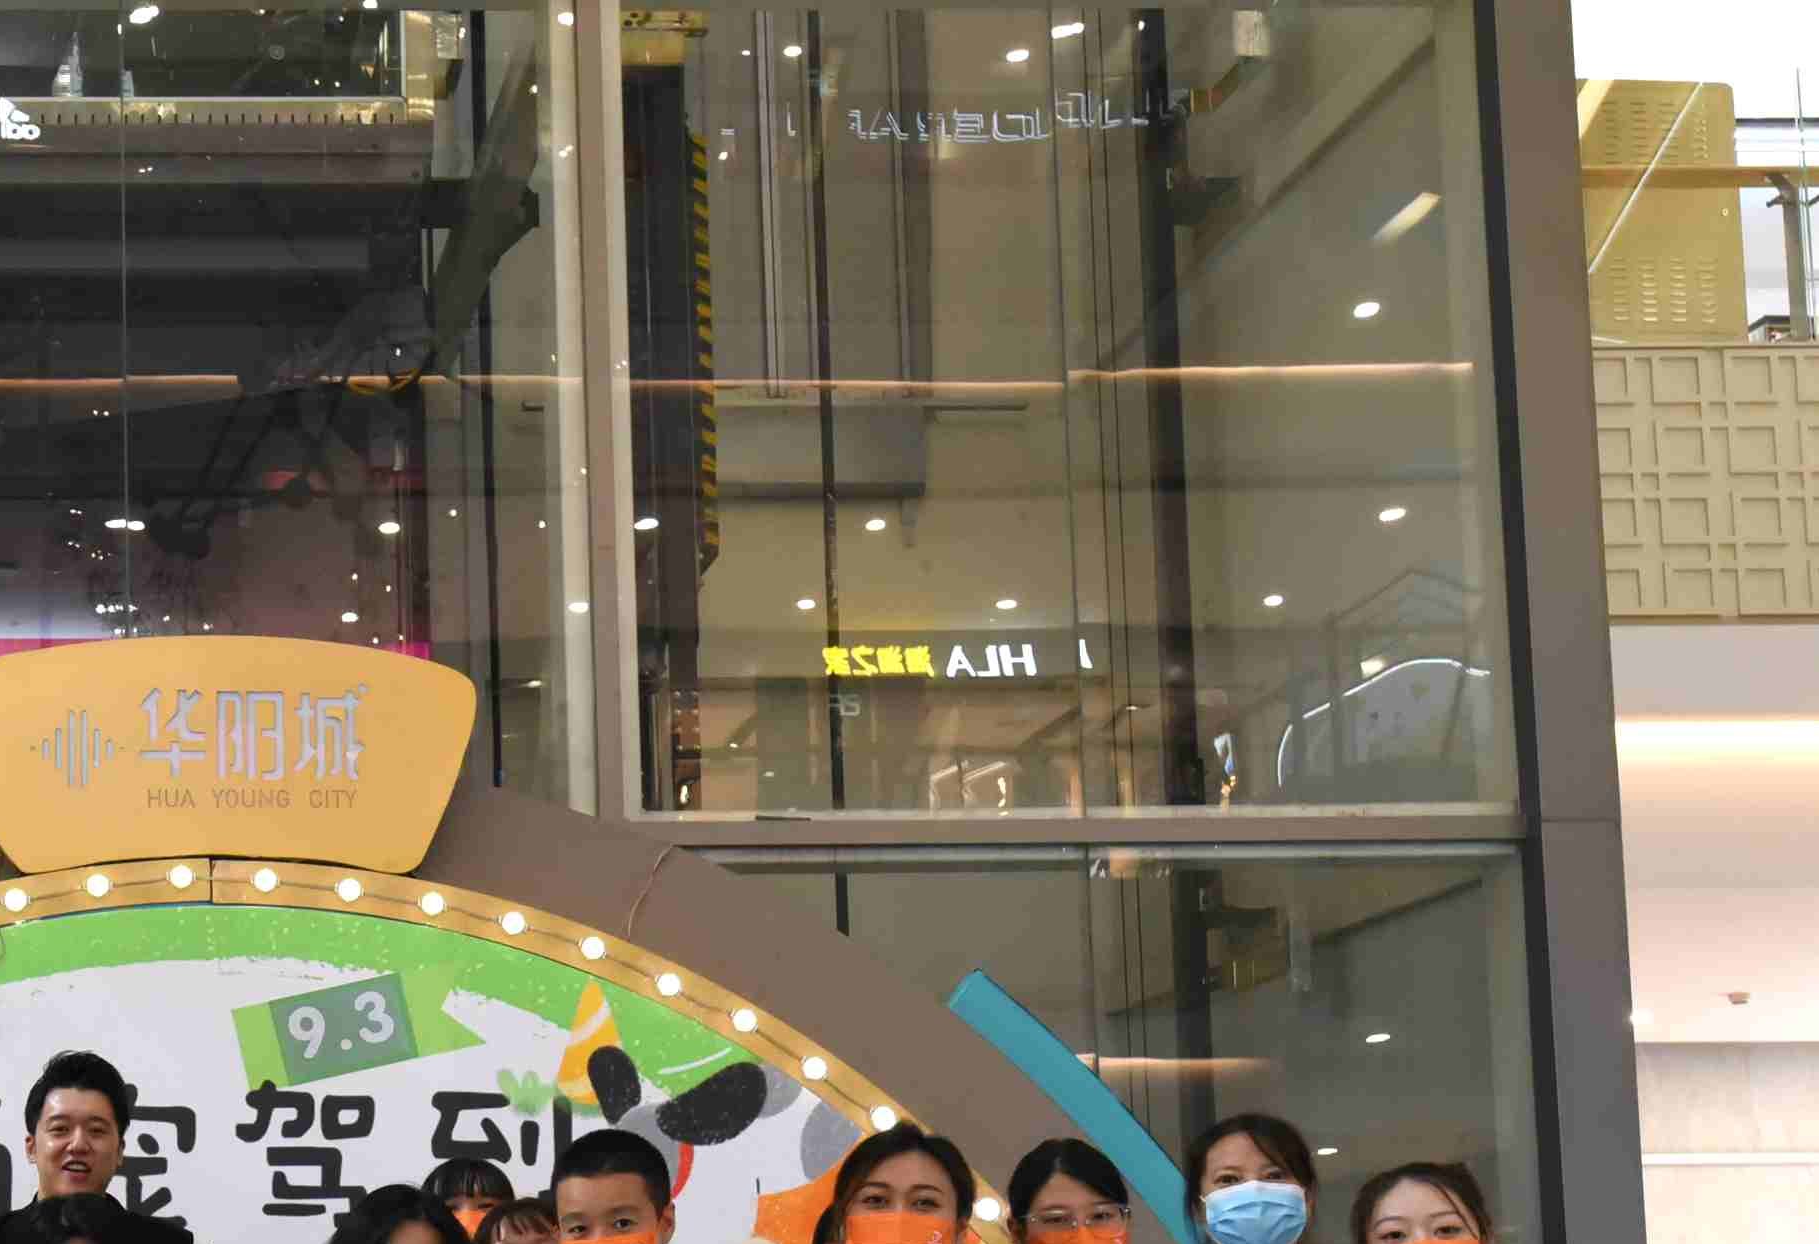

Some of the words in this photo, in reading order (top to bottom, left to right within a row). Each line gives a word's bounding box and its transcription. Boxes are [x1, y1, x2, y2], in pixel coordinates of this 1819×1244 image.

[138, 686, 366, 780] 华阳城
[147, 789, 196, 808] HUA
[211, 788, 290, 808] YOUNG
[309, 789, 357, 808] CITY
[288, 991, 394, 1059] 9.3
